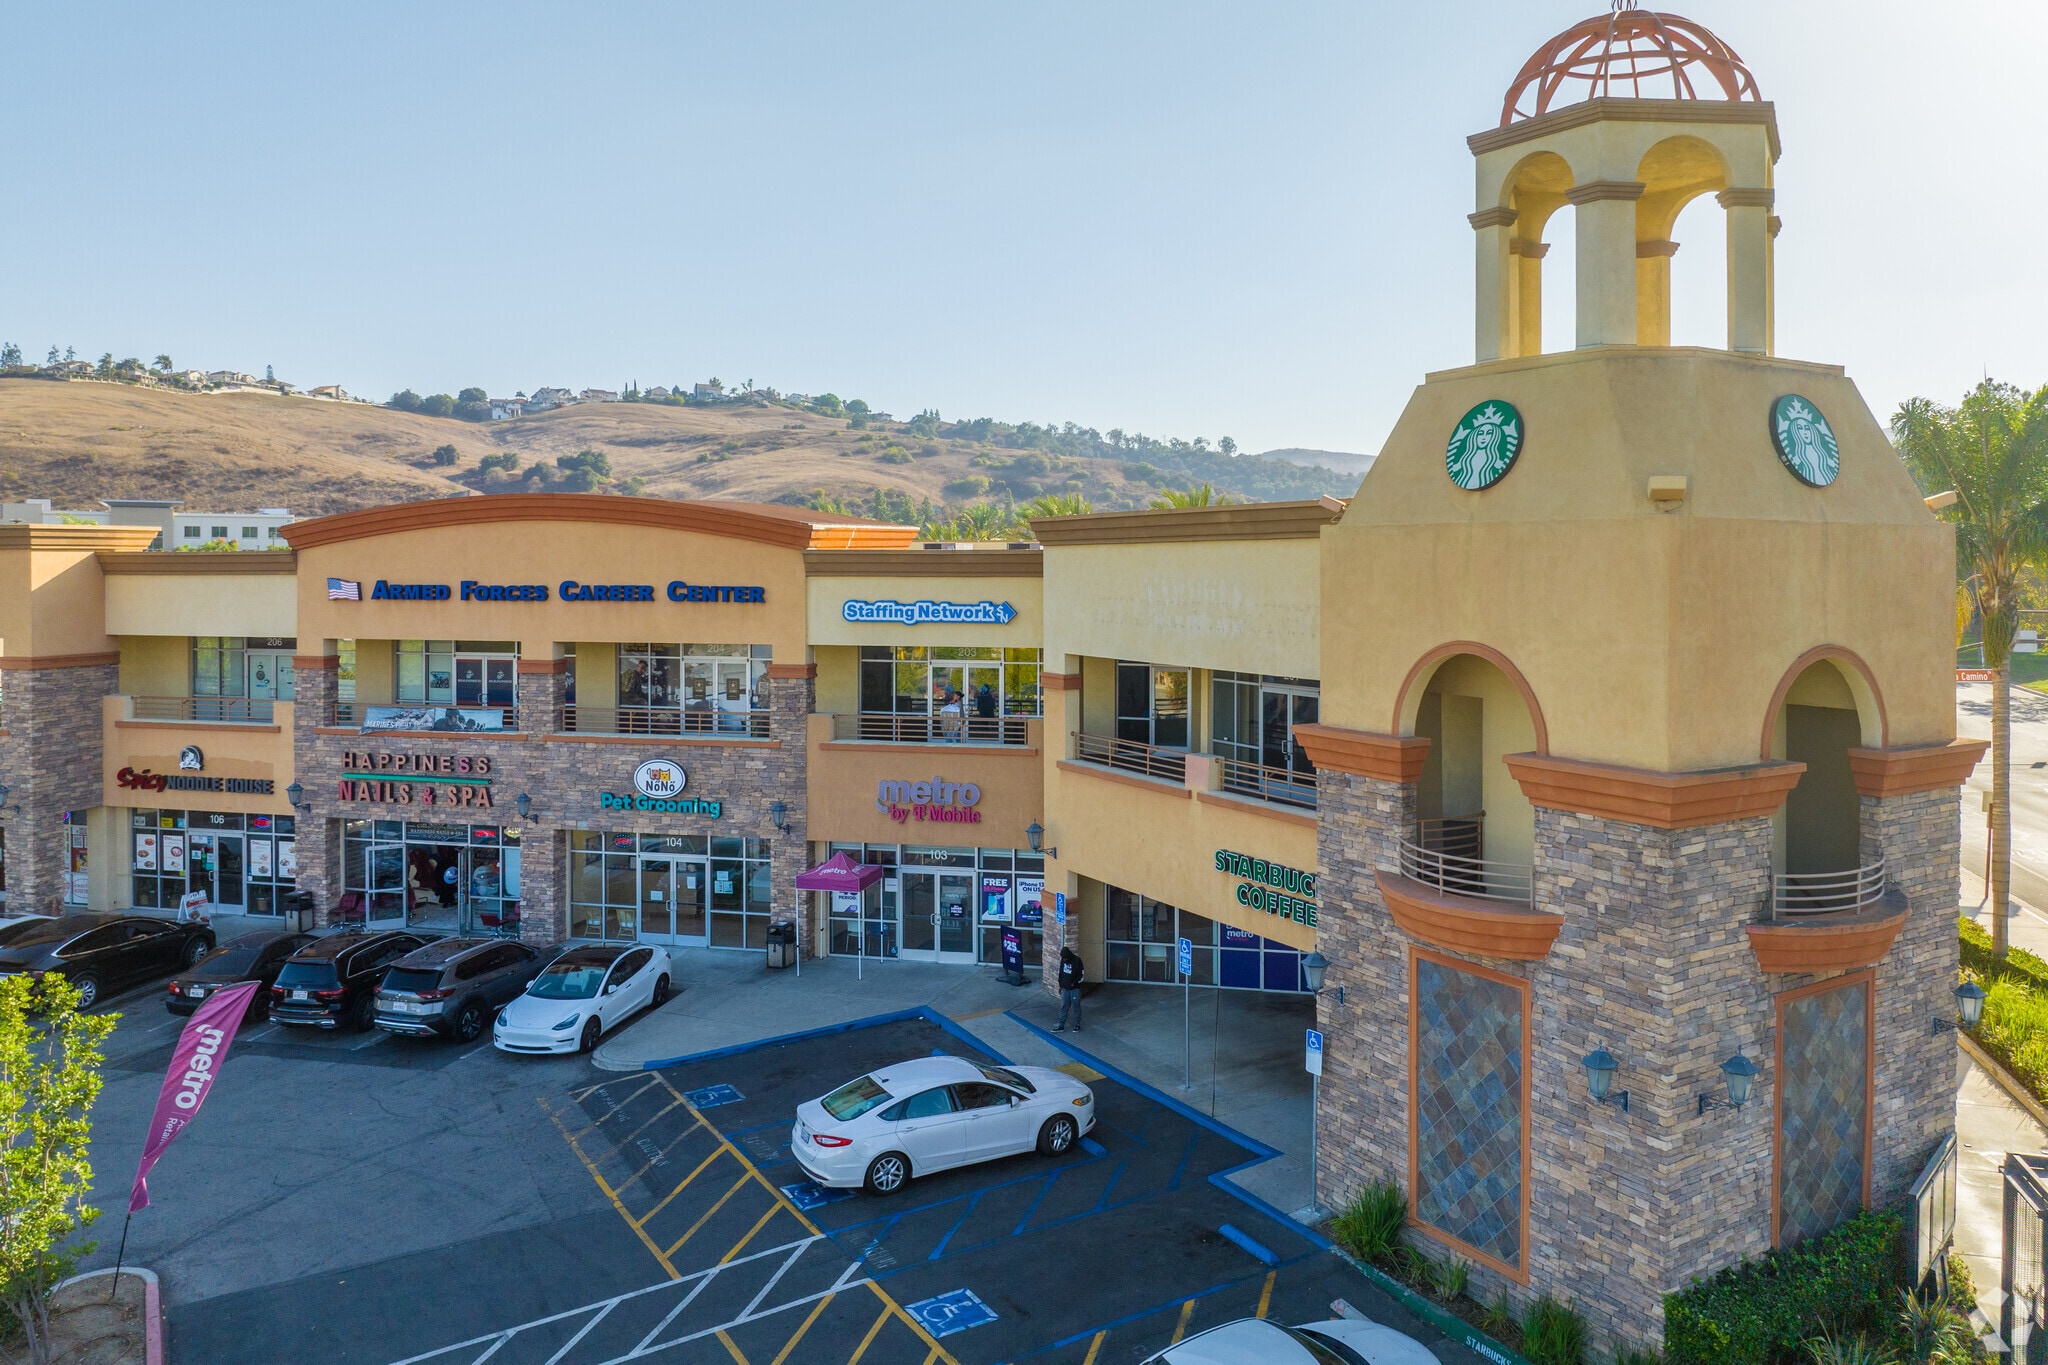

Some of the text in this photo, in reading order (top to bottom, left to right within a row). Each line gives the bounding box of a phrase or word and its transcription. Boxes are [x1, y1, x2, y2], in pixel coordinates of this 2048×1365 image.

[371, 580, 766, 603] ARMED FORCES CAREER CENTER
[845, 603, 994, 623] Staffing Network
[267, 637, 282, 646] 206
[707, 644, 725, 653] 204
[959, 648, 976, 658] 203
[1961, 672, 1988, 680] Camino
[341, 752, 492, 775] HAPPINESS
[167, 775, 223, 792] NOODLE
[225, 778, 274, 795] HOUSE
[339, 781, 492, 808] NAILS & SPA
[876, 776, 980, 809] metro
[601, 792, 722, 819] Pet Grooming
[889, 804, 910, 825] by
[928, 805, 981, 824] Mobile
[210, 814, 225, 824] 106
[666, 837, 682, 847] 104
[929, 850, 947, 860] 103
[819, 867, 847, 875] metro
[1214, 849, 1318, 900] STARBUC
[984, 878, 1008, 886] FREE
[1236, 883, 1318, 928] COFFEE
[1226, 929, 1254, 939] metro
[175, 1024, 224, 1109] metro
